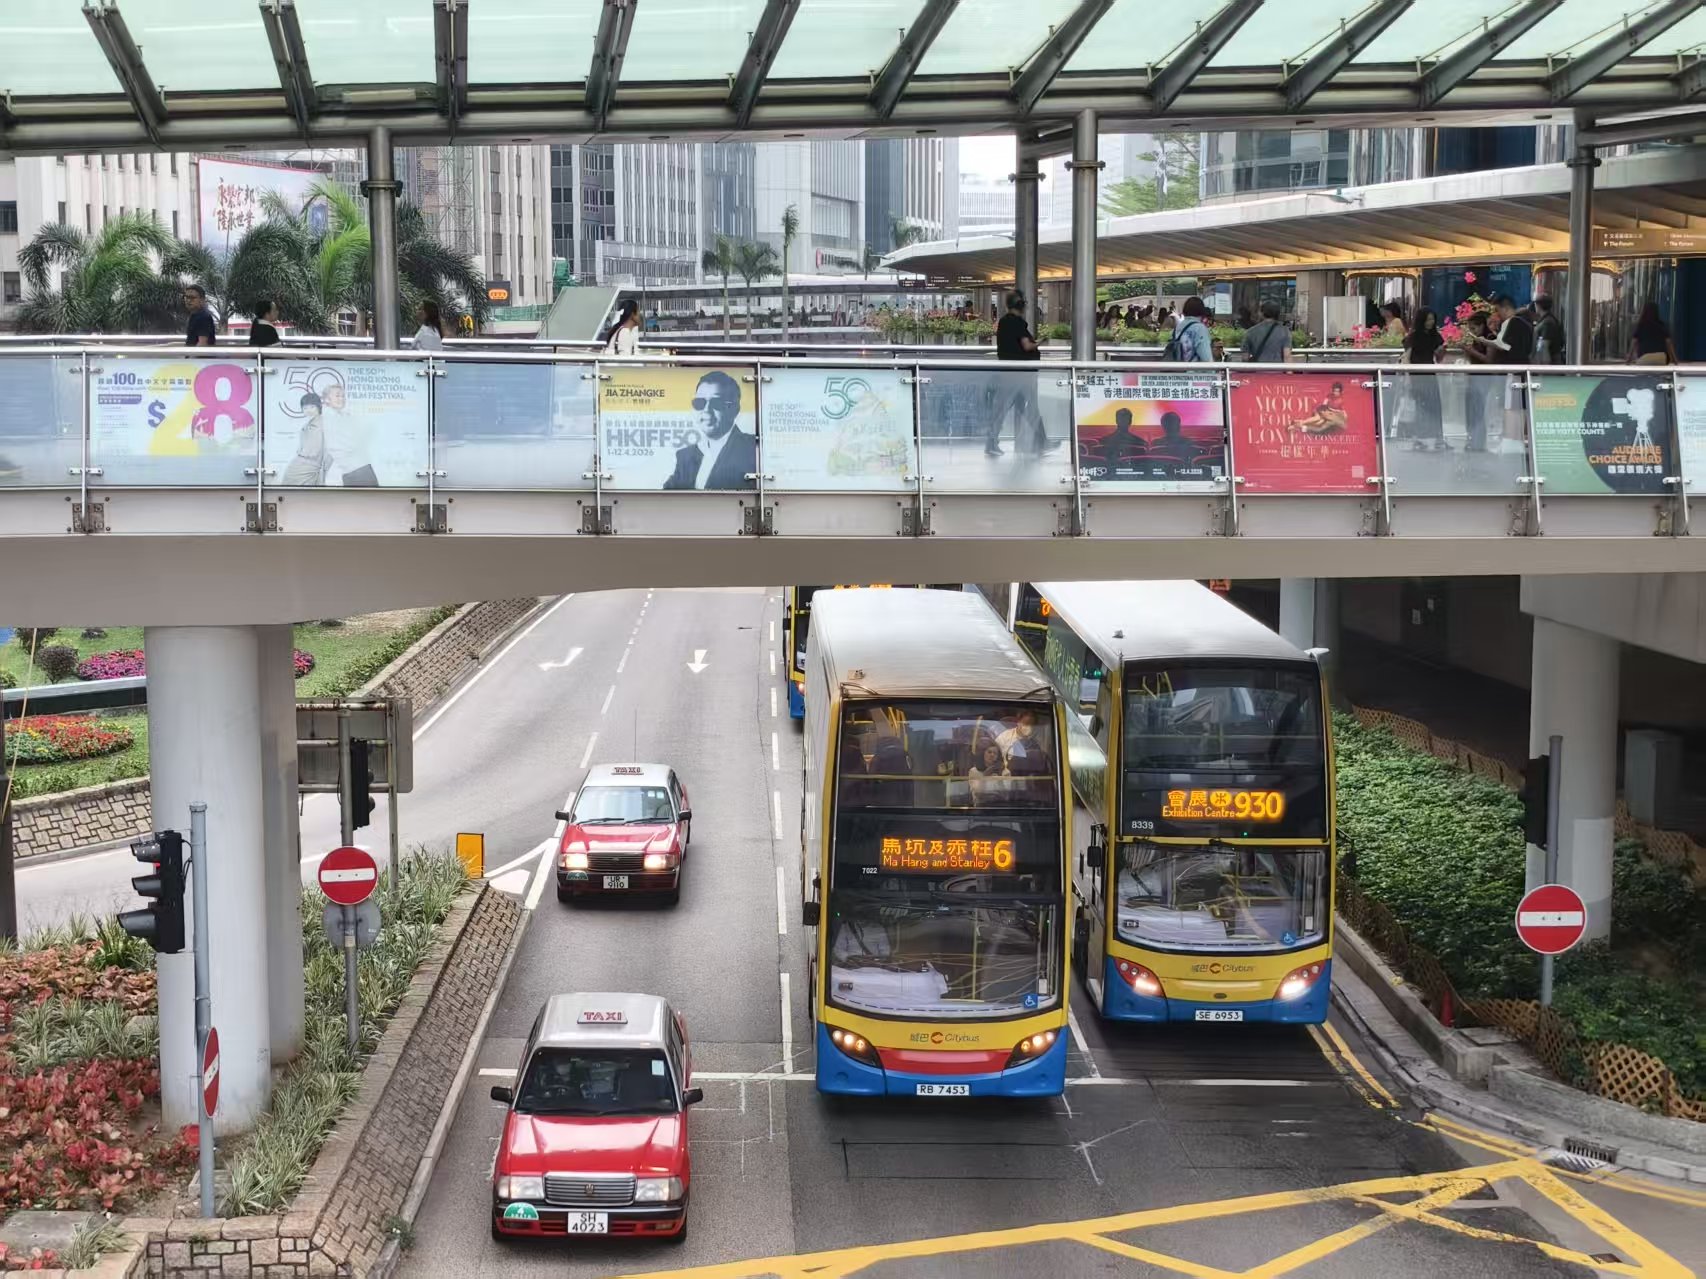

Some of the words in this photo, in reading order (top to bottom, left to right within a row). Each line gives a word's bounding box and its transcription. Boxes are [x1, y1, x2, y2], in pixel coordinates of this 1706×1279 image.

[347, 375, 374, 383] HONG
[375, 376, 401, 384] KONG
[347, 384, 417, 392] INTERNATIONAL
[1103, 387, 1219, 399] 香港國際電影節金禧紀念展
[1260, 385, 1273, 395] IN
[1276, 385, 1297, 395] THE
[368, 392, 406, 400] FESTIVAL
[605, 389, 618, 397] JIA
[619, 389, 665, 398] ZHANGKE
[1259, 413, 1292, 426] FOR
[606, 428, 701, 448] HKIFF50
[1303, 434, 1313, 443] IN
[1589, 455, 1628, 464] CHOICE
[1167, 789, 1208, 807] 會展
[1234, 791, 1283, 818] 930
[1162, 806, 1203, 818] Exhibition
[1204, 806, 1235, 818] Centre
[1131, 820, 1154, 829] 8339
[993, 839, 1012, 868] 6
[883, 855, 898, 867] Ma
[901, 855, 929, 868] Hang
[931, 857, 948, 867] and
[950, 855, 990, 869] Stanley
[608, 881, 625, 889] 9110
[1222, 964, 1255, 974] Citybus
[583, 1011, 622, 1021] TAXI
[1198, 1010, 1211, 1020] SE
[1214, 1011, 1240, 1020] 6953
[944, 1032, 980, 1044] Citybus
[920, 1084, 934, 1095] RB
[939, 1084, 967, 1095] 7453
[580, 1212, 597, 1222] SH
[571, 1222, 605, 1233] 4023
